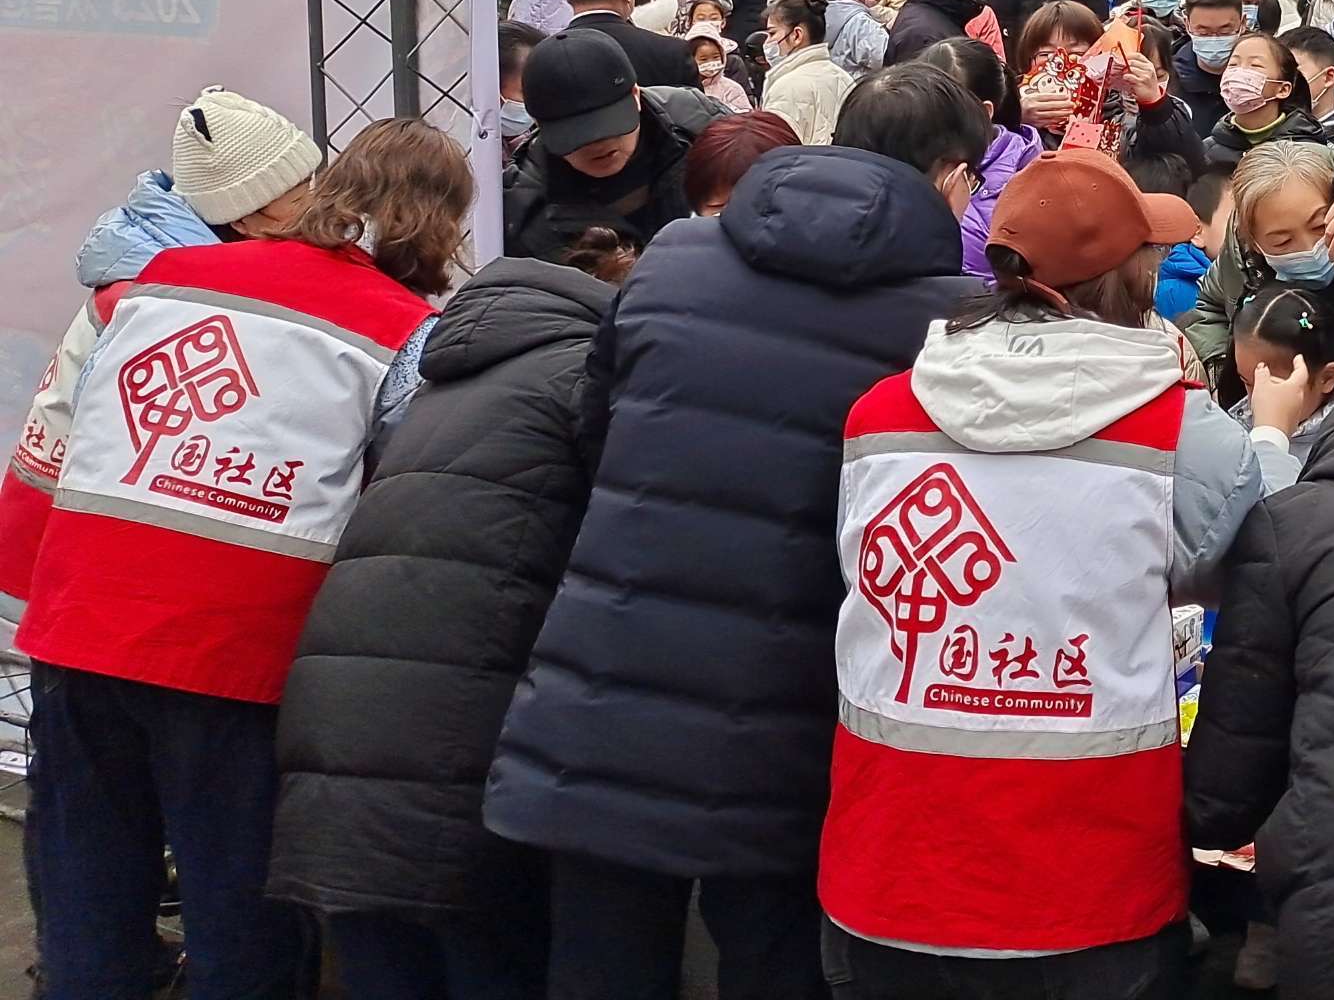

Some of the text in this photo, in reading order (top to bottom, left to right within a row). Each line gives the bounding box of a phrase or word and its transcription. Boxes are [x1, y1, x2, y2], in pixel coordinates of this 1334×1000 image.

[21, 451, 60, 477] Communi
[155, 477, 283, 519] Chinese Community
[929, 687, 1086, 714] Chinese Community
